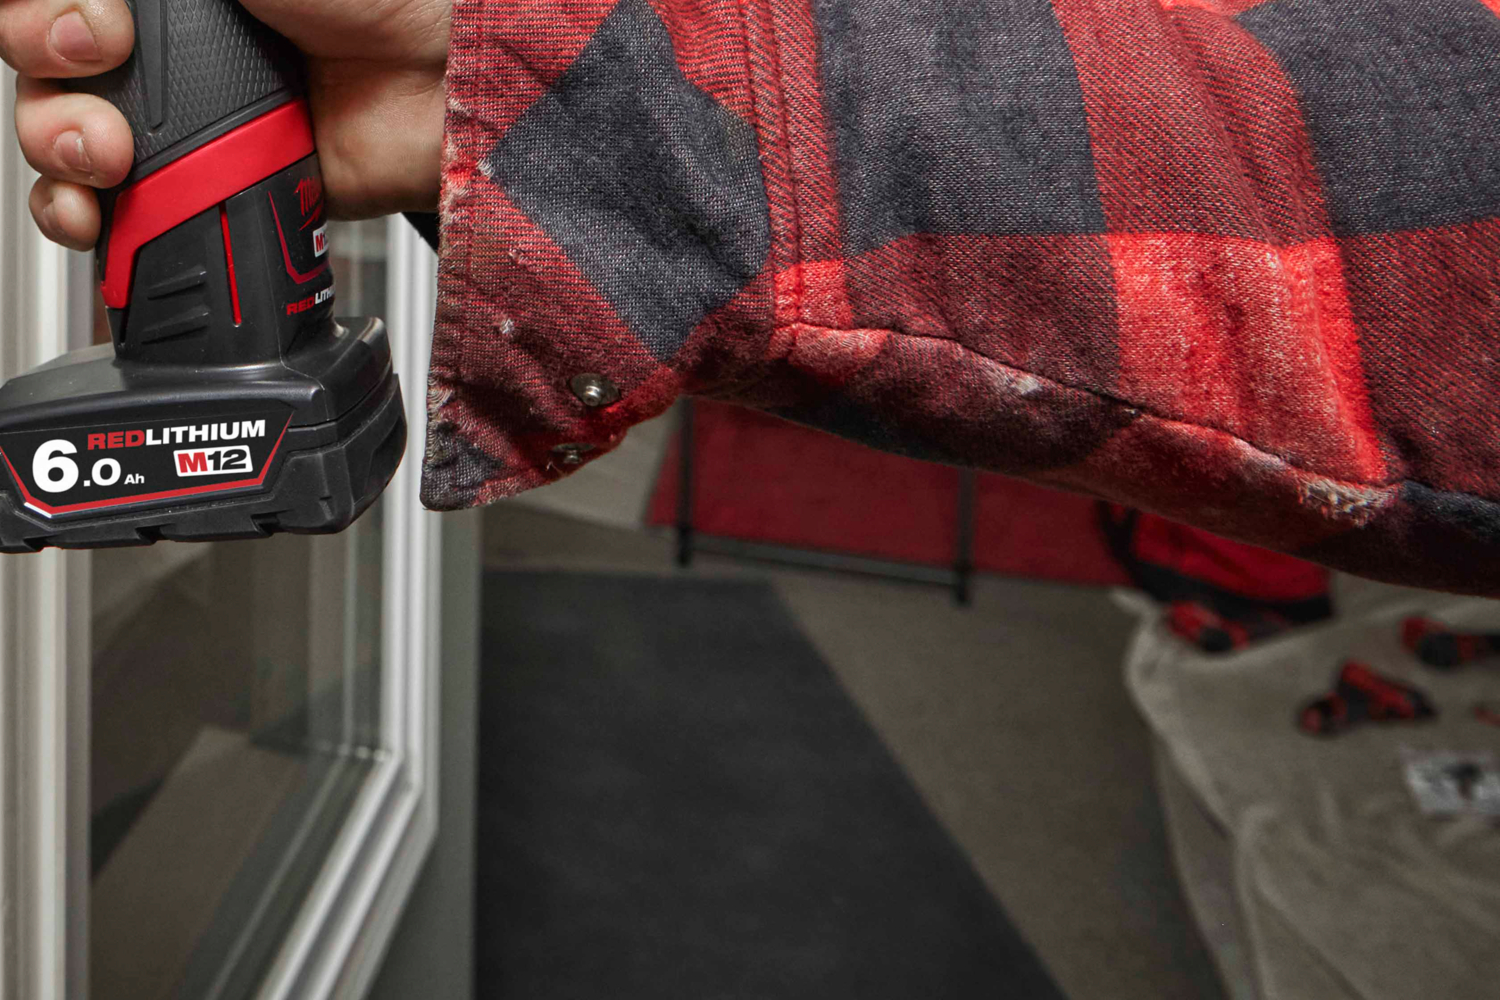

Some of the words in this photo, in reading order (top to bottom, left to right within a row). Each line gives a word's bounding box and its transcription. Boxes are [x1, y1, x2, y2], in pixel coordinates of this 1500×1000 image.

[87, 419, 266, 450] REDLITHIUM
[32, 439, 122, 493] 6.0
[124, 473, 145, 485] Ah
[177, 449, 248, 473] M12
